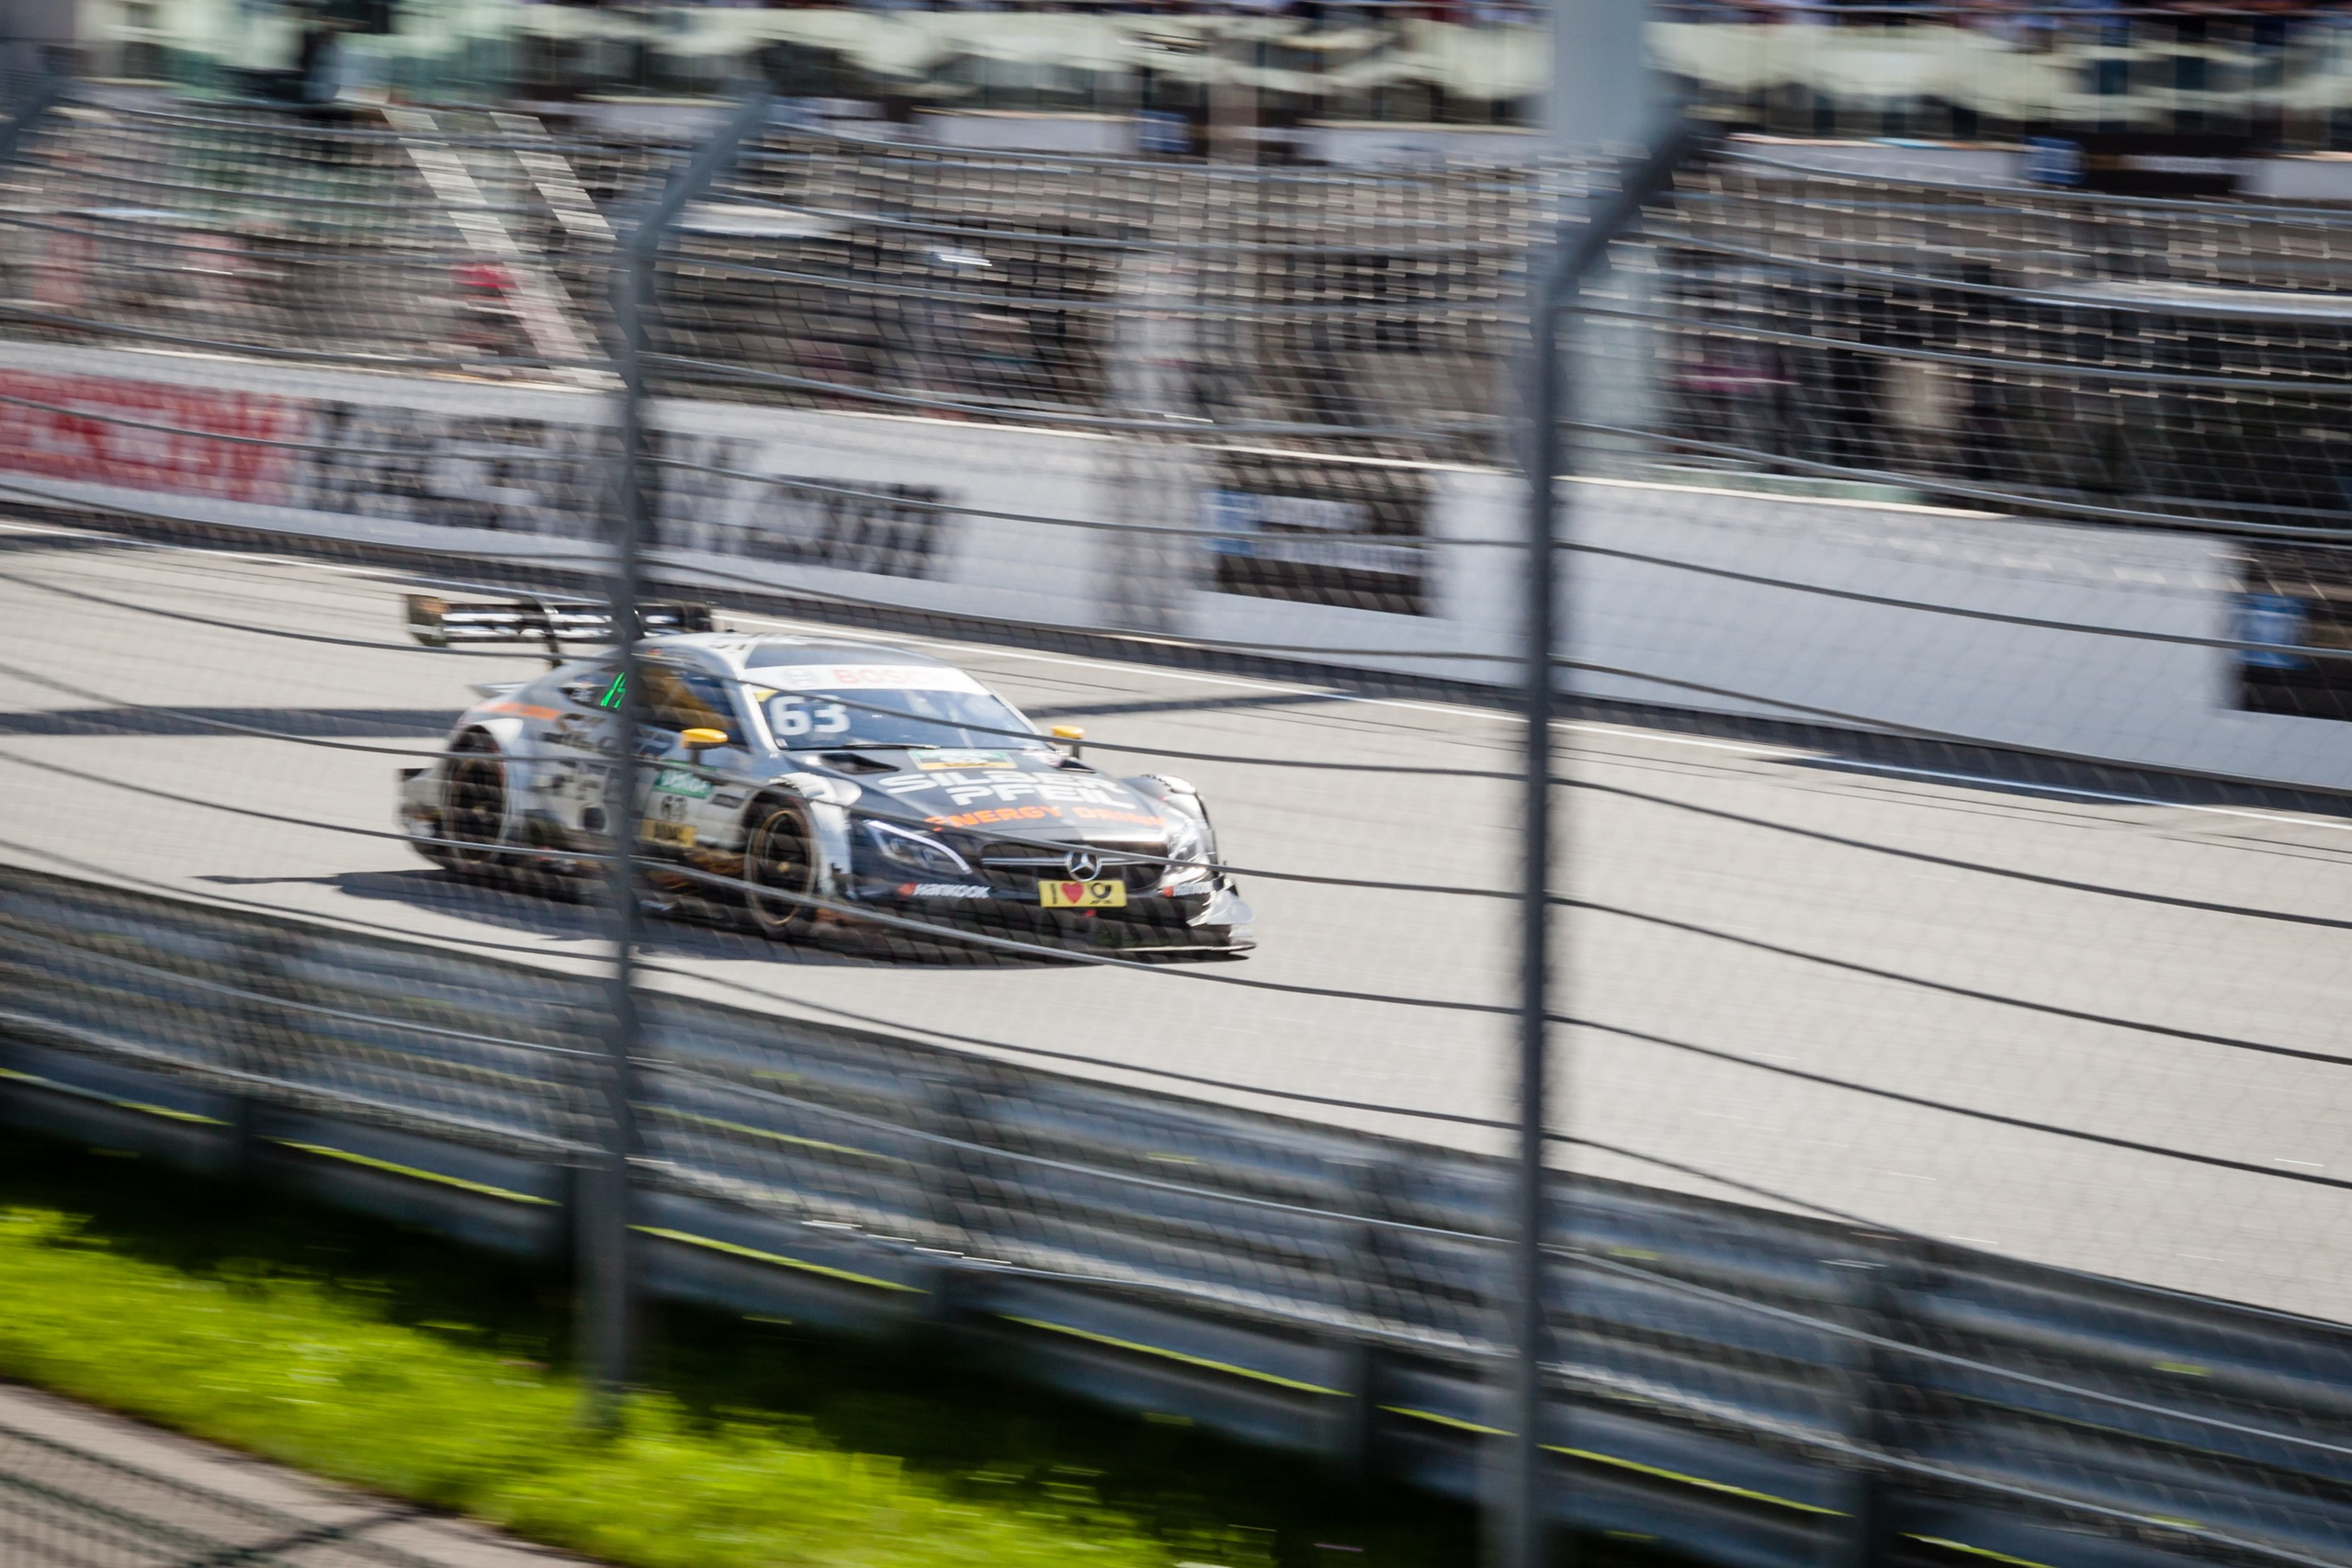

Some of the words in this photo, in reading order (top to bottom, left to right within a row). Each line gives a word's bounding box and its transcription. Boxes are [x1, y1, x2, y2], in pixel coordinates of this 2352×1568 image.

[768, 694, 851, 736] 63
[877, 770, 1129, 795] SILBER
[945, 783, 1137, 810] PFEIL
